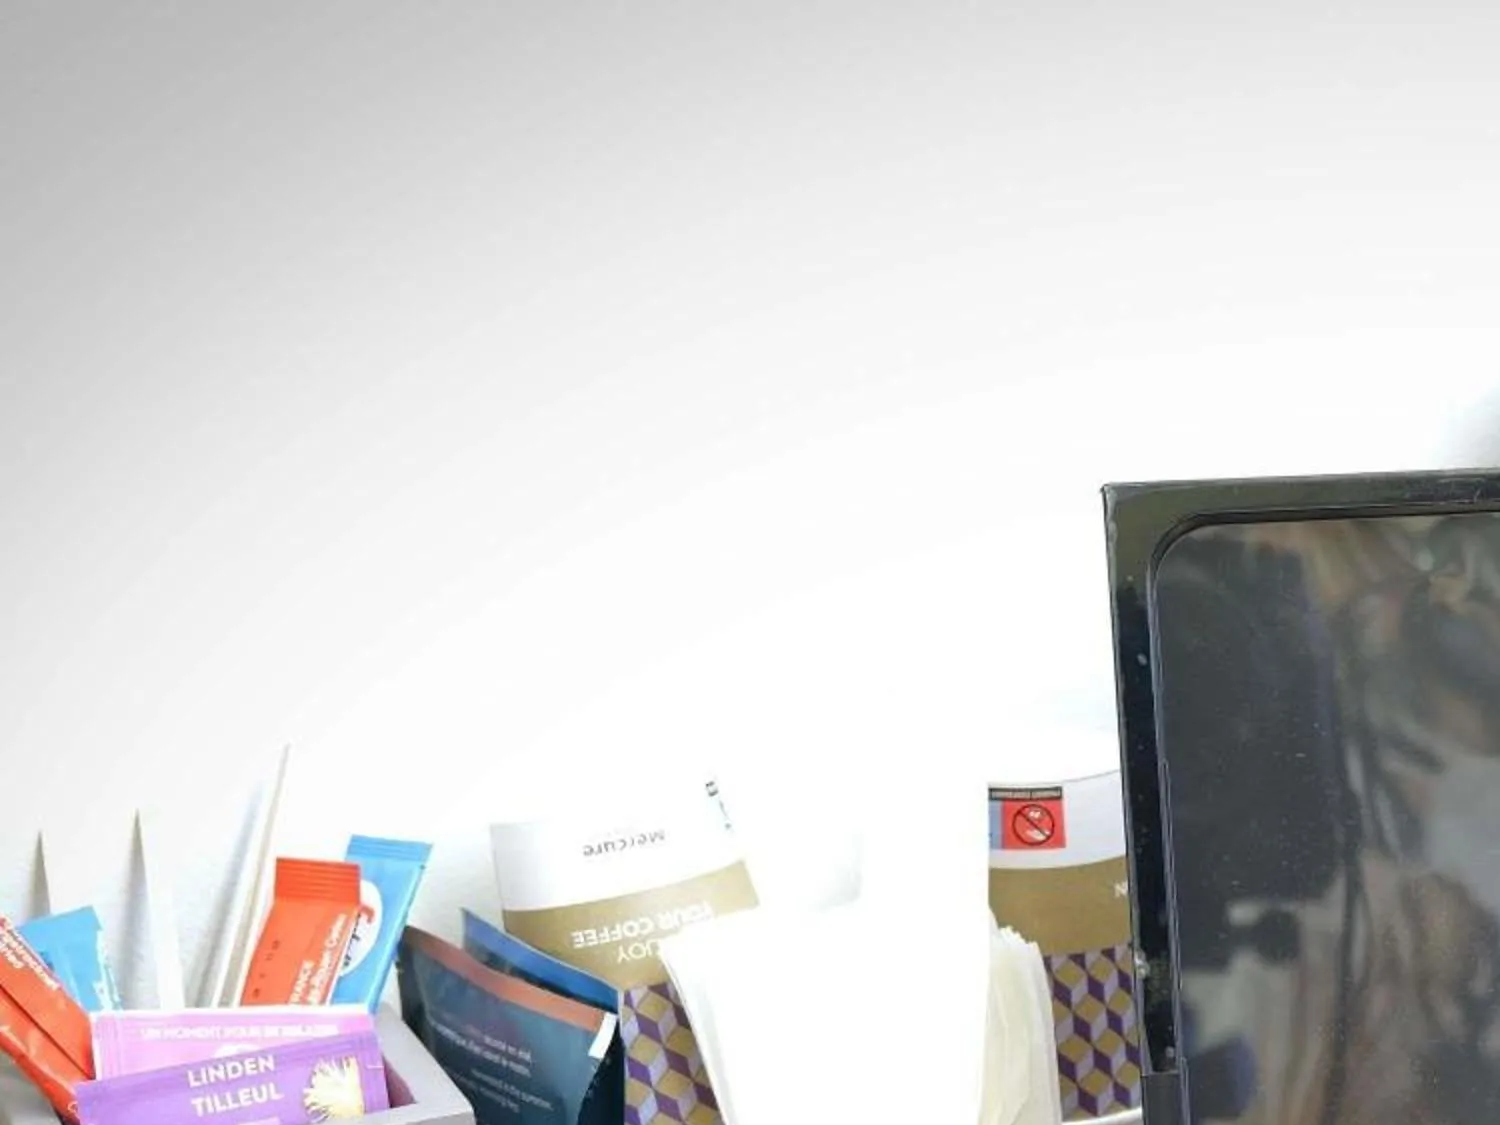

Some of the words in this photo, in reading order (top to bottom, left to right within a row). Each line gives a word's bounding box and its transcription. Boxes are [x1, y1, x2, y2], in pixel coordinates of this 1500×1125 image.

[582, 829, 666, 857] Mercure
[571, 917, 654, 949] COFFEE
[187, 1054, 276, 1088] LINDEN
[190, 1082, 285, 1117] TILLEUL
